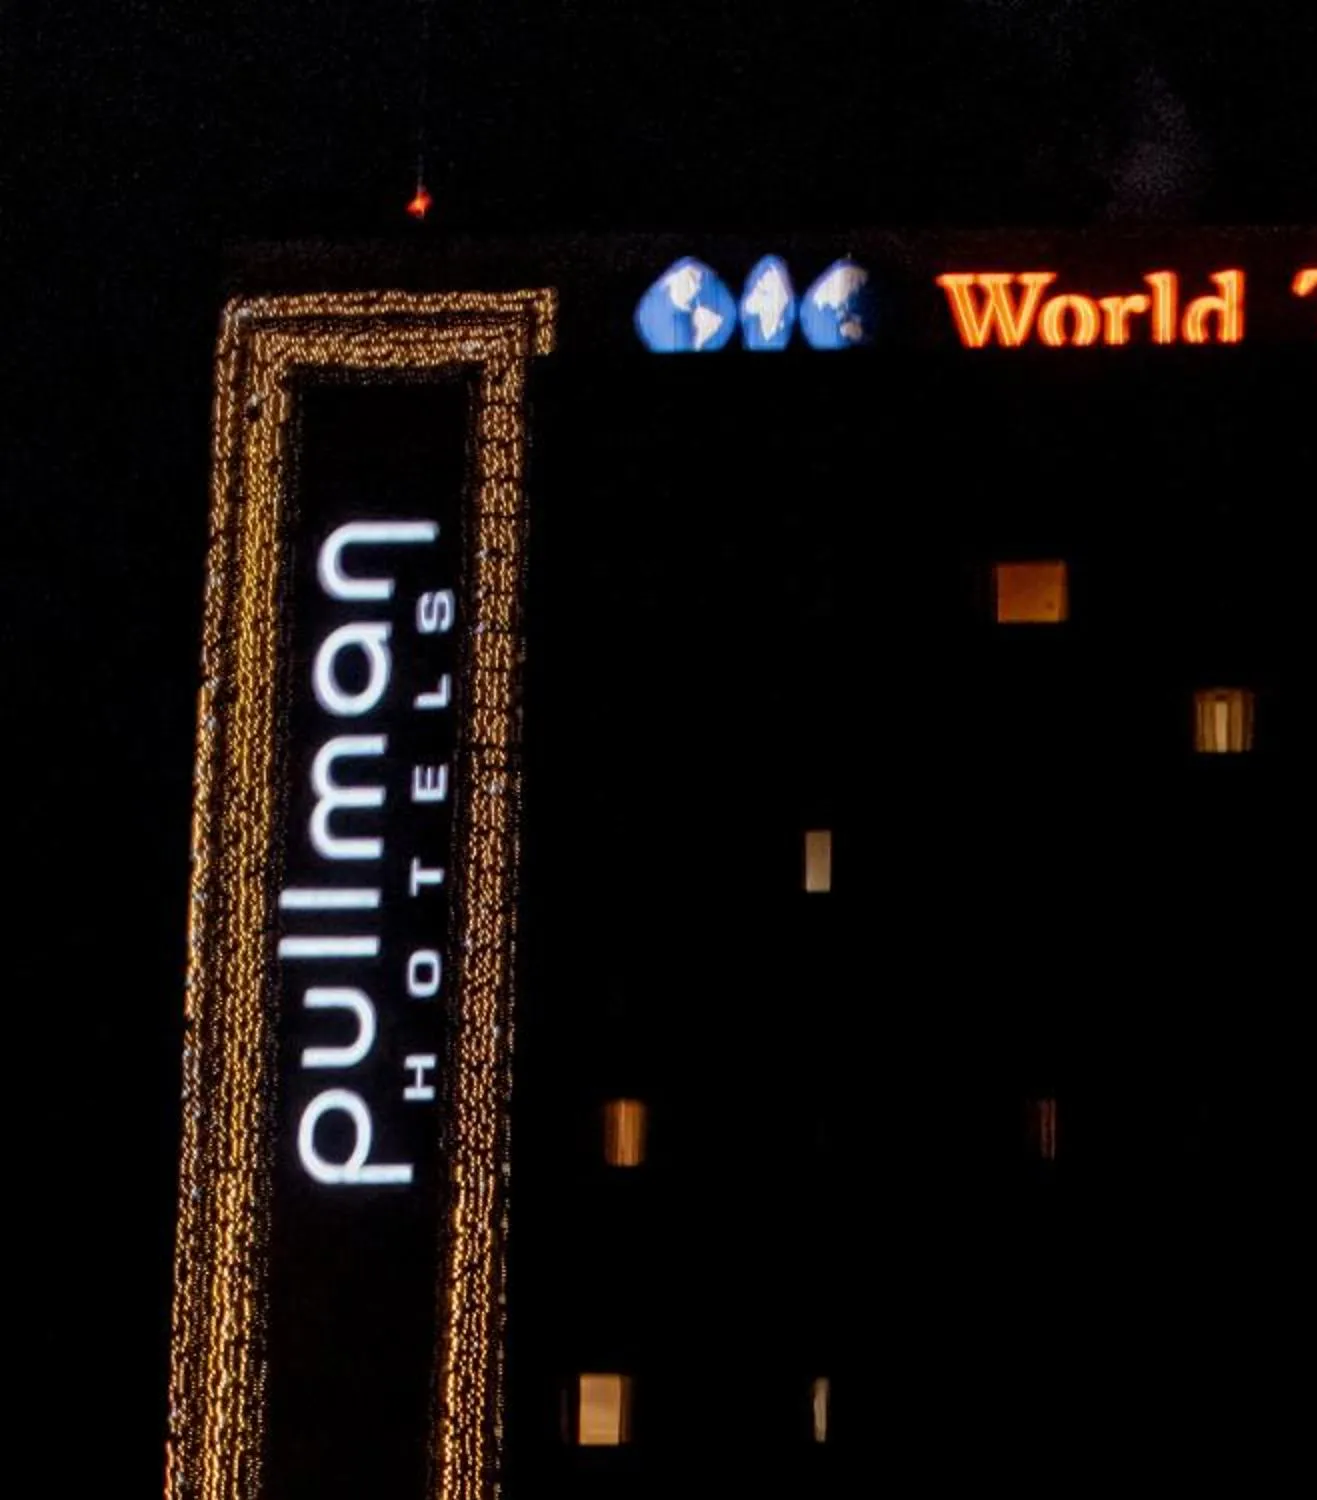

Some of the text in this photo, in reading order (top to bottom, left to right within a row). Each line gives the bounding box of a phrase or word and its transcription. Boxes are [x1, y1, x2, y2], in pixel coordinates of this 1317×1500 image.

[935, 268, 1245, 348] World
[278, 521, 438, 1185] pullman
[404, 591, 454, 1100] HOTELS
